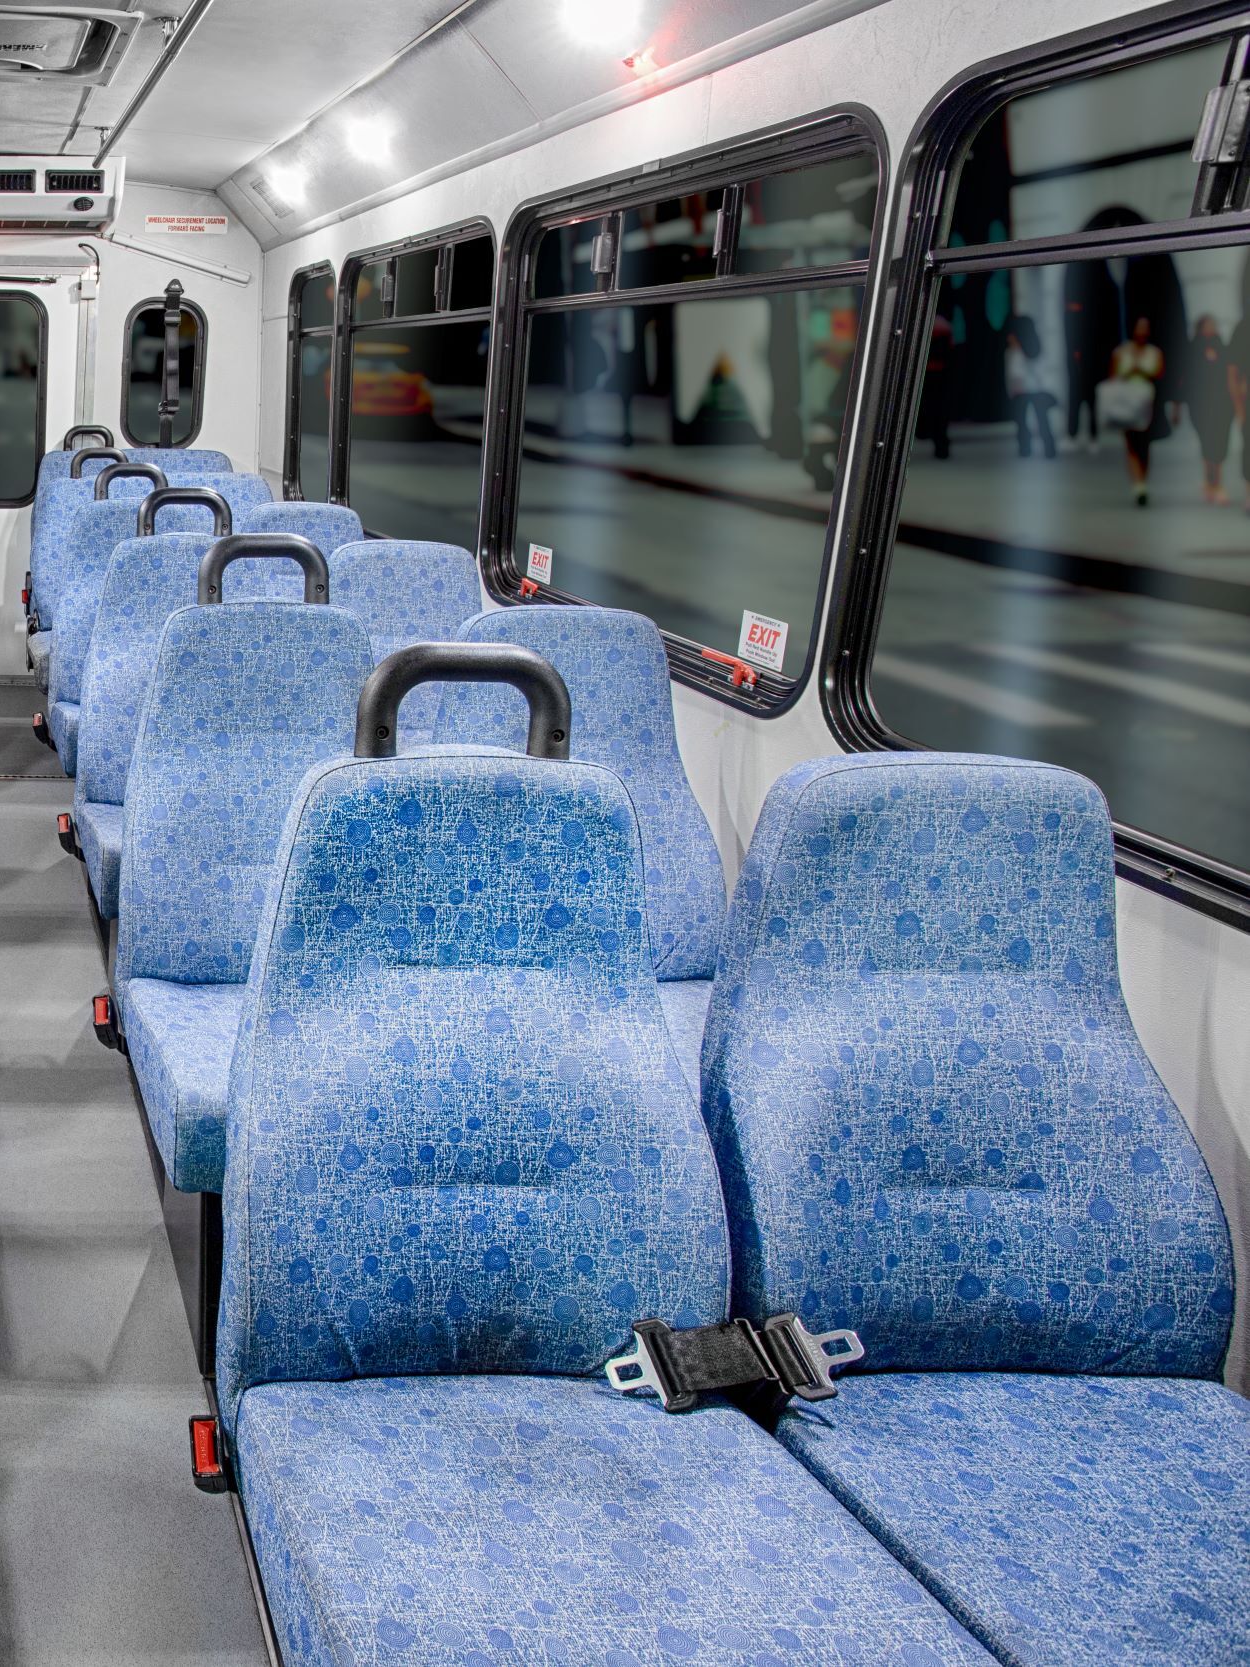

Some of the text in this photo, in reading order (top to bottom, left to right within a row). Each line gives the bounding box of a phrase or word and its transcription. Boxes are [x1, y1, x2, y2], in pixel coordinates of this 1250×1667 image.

[147, 216, 176, 224] WHEELCHAIR
[205, 217, 226, 225] LOCATION
[532, 551, 549, 569] EXIT
[748, 623, 781, 650] EXIT
